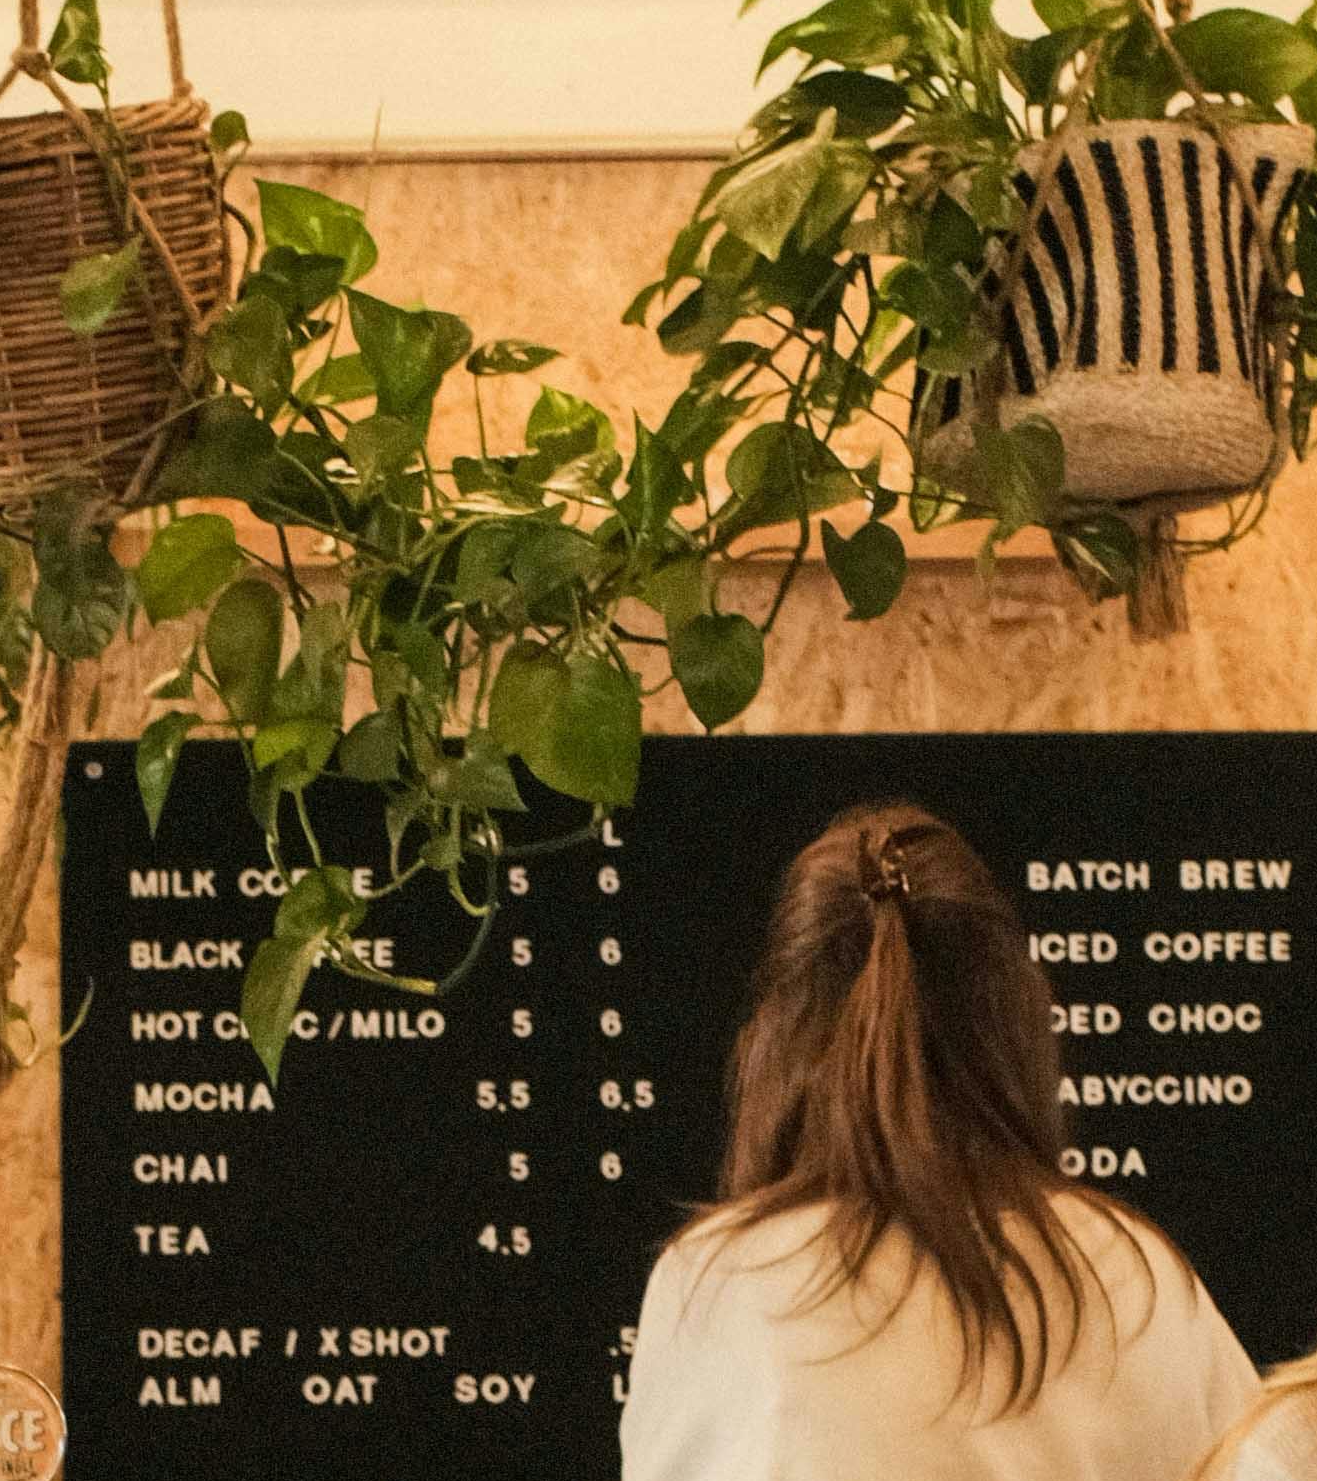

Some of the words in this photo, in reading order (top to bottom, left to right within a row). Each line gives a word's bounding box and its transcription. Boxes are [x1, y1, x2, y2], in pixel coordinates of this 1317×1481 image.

[130, 870, 216, 898] MILK
[238, 868, 374, 898] COE
[508, 867, 529, 896] 5
[598, 866, 620, 895] 6
[1027, 861, 1150, 891] BATCH
[1179, 860, 1292, 890] BREW
[130, 940, 243, 970] BLACK
[512, 938, 532, 967] 5
[599, 938, 622, 966] 6
[1028, 932, 1118, 963] ICED
[1143, 931, 1292, 962] COFFEE
[131, 1011, 202, 1041] HOT
[213, 1011, 320, 1040] CC
[351, 1009, 446, 1039] MILO
[512, 1009, 533, 1038] 5
[600, 1009, 622, 1037] 6
[1147, 1003, 1262, 1034] CHOC
[134, 1082, 275, 1112] MOCHA
[477, 1081, 531, 1112] 5.5
[600, 1080, 655, 1112] 6.5
[1055, 1075, 1252, 1106] ABYCCINO
[133, 1154, 228, 1184] CHAI
[509, 1152, 529, 1181] 5
[600, 1152, 623, 1180] 6
[1058, 1147, 1148, 1177] ODA
[134, 1225, 210, 1255] TEA
[477, 1225, 532, 1255] 4.5
[138, 1328, 261, 1359] DECAF
[318, 1327, 340, 1357] X
[349, 1326, 450, 1358] SHOT
[138, 1376, 221, 1406] ALM
[302, 1375, 378, 1405] OAT
[454, 1374, 536, 1404] SOY
